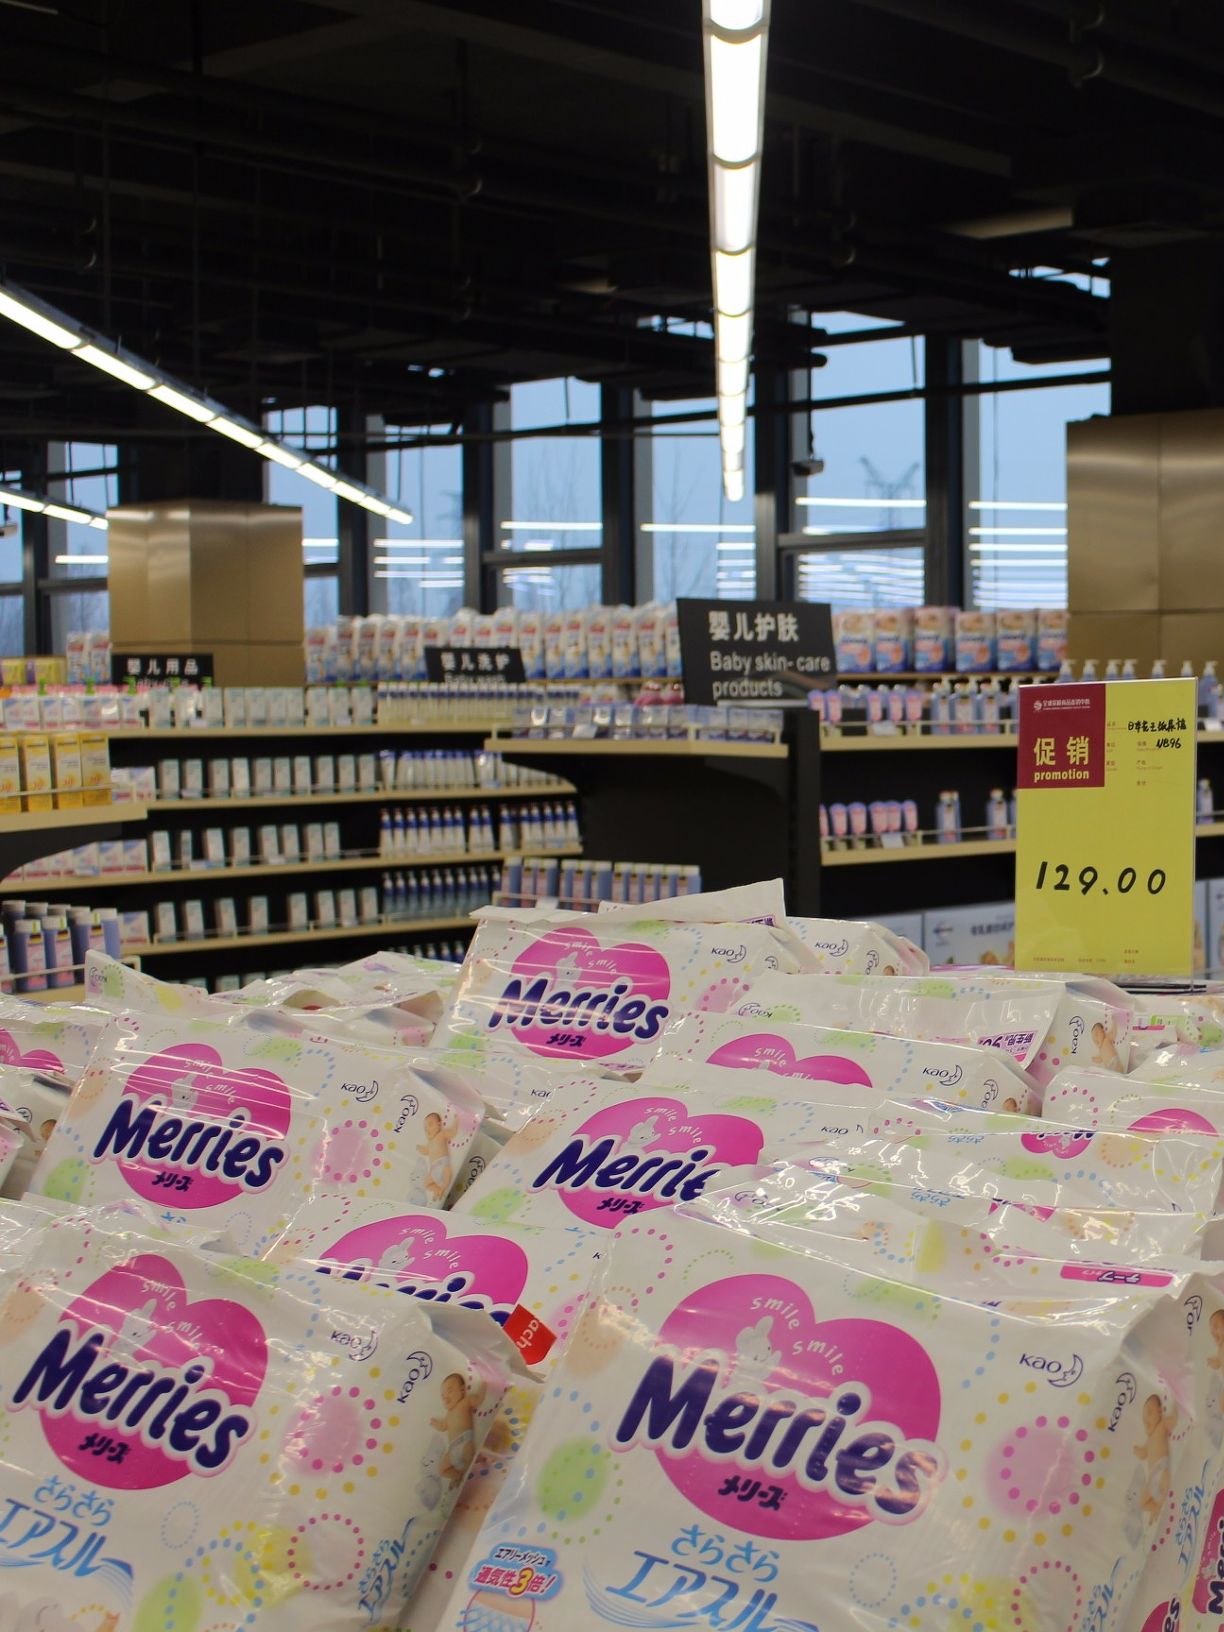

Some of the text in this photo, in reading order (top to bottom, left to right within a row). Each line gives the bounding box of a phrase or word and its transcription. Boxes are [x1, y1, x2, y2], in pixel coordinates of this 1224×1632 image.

[708, 610, 799, 643] 婴儿护肤
[127, 657, 199, 676] 婴儿用品
[710, 650, 752, 675] Baby
[712, 679, 783, 699] products
[1033, 736, 1090, 766] 促销
[1033, 769, 1090, 783] promotion
[1035, 861, 1167, 897] 129.00
[711, 946, 735, 957] kao
[815, 940, 836, 950] kao
[488, 978, 669, 1039] Merries
[546, 1033, 586, 1048] メリーズ
[754, 1046, 788, 1068] smile
[922, 1066, 949, 1079] kao
[340, 1081, 368, 1095] kao
[394, 1106, 411, 1134] kao
[643, 1105, 677, 1123] smile
[93, 1098, 285, 1189] Merries
[668, 1124, 702, 1144] smile
[820, 1125, 849, 1136] kao
[151, 1171, 195, 1193] メリーズ
[399, 1226, 436, 1245] smile
[423, 1248, 462, 1270] smile
[138, 1279, 177, 1312] smile
[751, 1295, 801, 1330] smile
[331, 1330, 362, 1349] kao
[792, 1338, 844, 1376] smile
[1018, 1352, 1062, 1374] kao
[13, 1328, 249, 1469] Merries
[397, 1367, 422, 1404] kao
[1108, 1392, 1127, 1433] kao
[616, 1354, 939, 1516] Merries
[78, 1432, 133, 1465] メリーズ
[32, 1474, 116, 1527] さらさら
[717, 1474, 788, 1511] メリーズ
[670, 1523, 781, 1584] さらさら
[605, 1549, 779, 1632] エアスル
